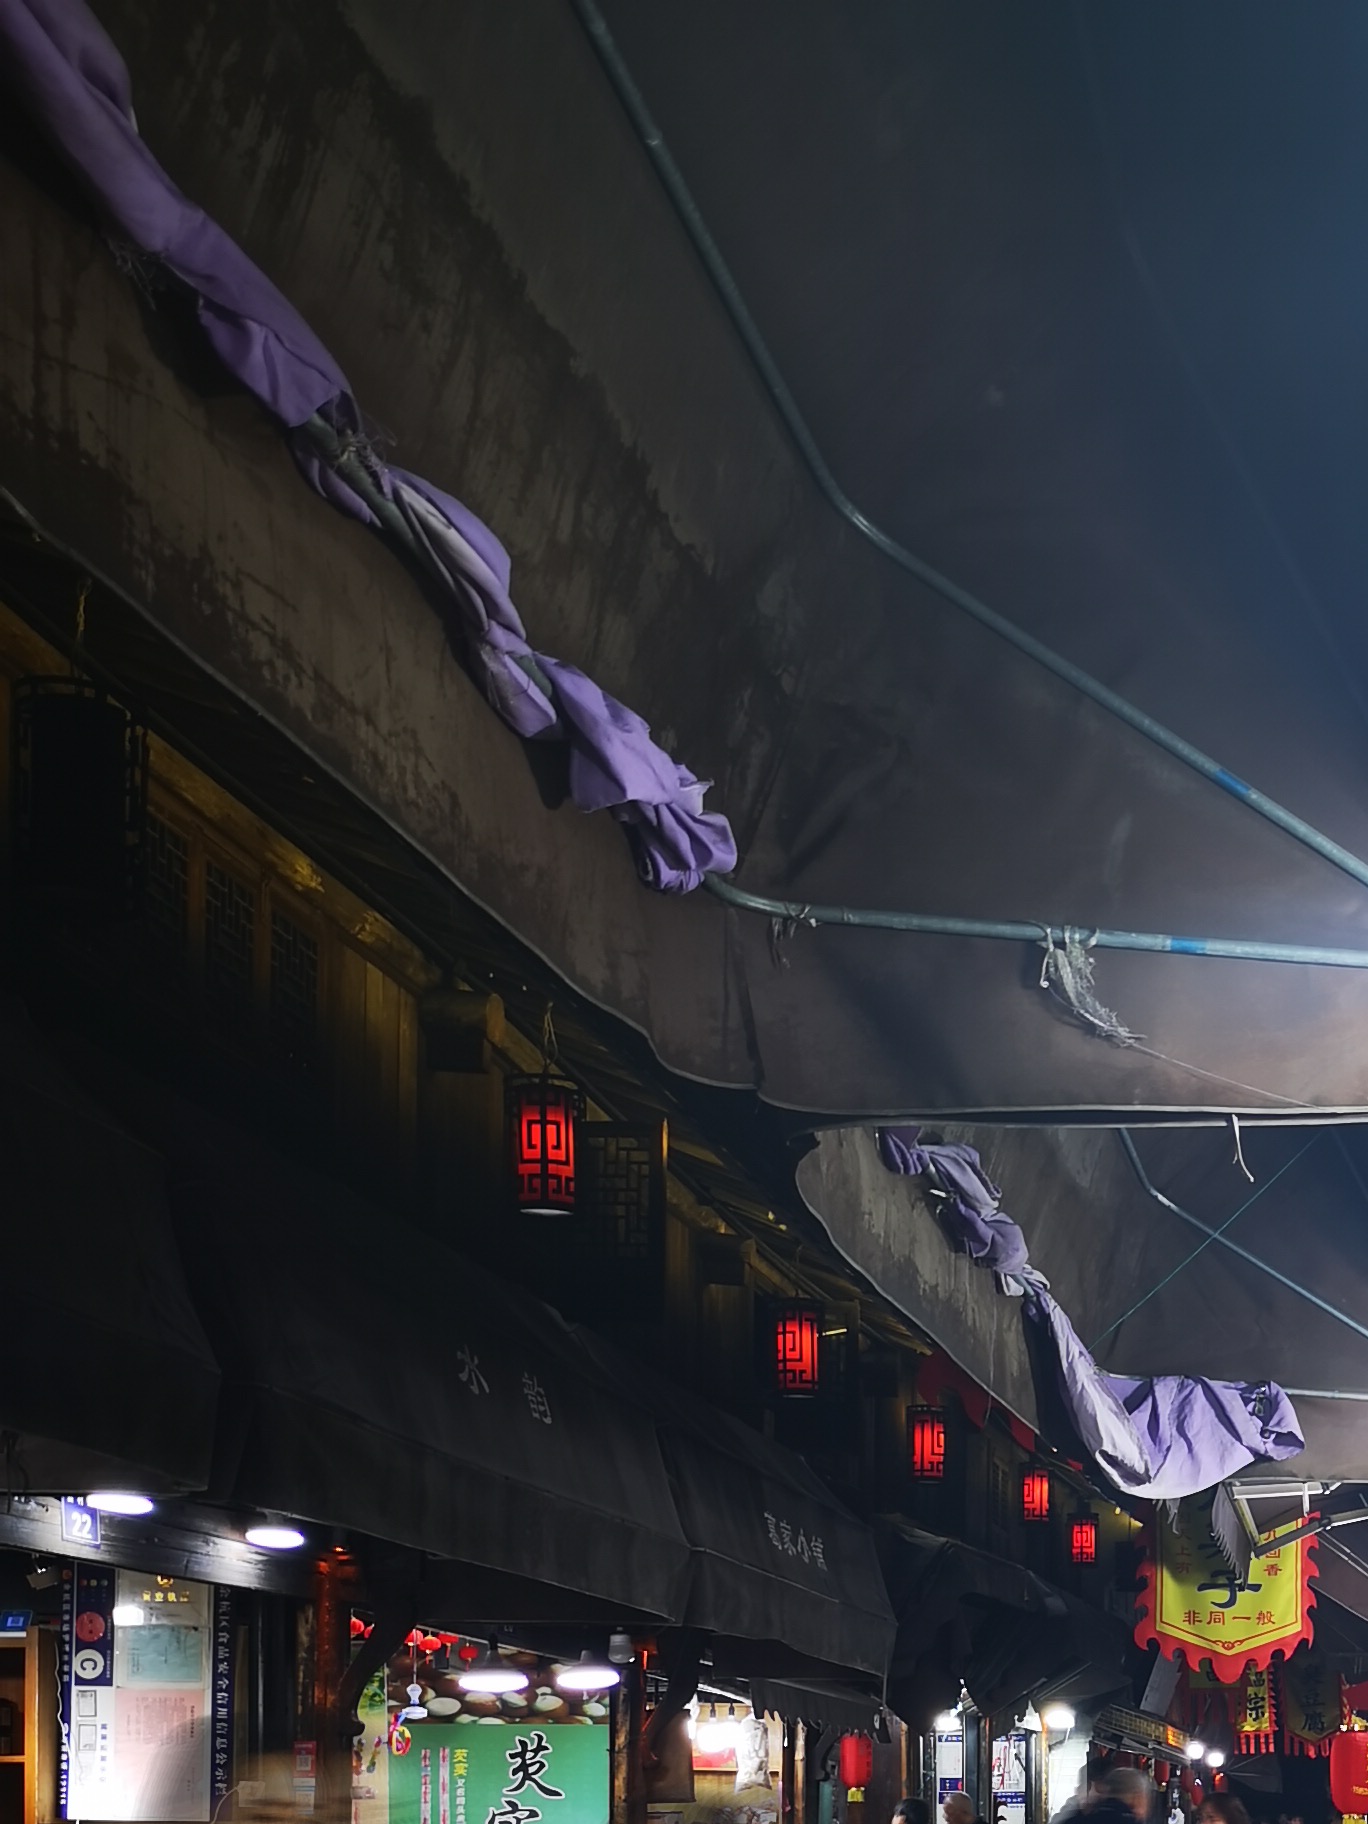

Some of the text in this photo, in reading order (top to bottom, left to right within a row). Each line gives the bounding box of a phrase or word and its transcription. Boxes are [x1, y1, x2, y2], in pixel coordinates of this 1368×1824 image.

[71, 1511, 92, 1539] 22
[1183, 1610, 1276, 1626] 非同一般
